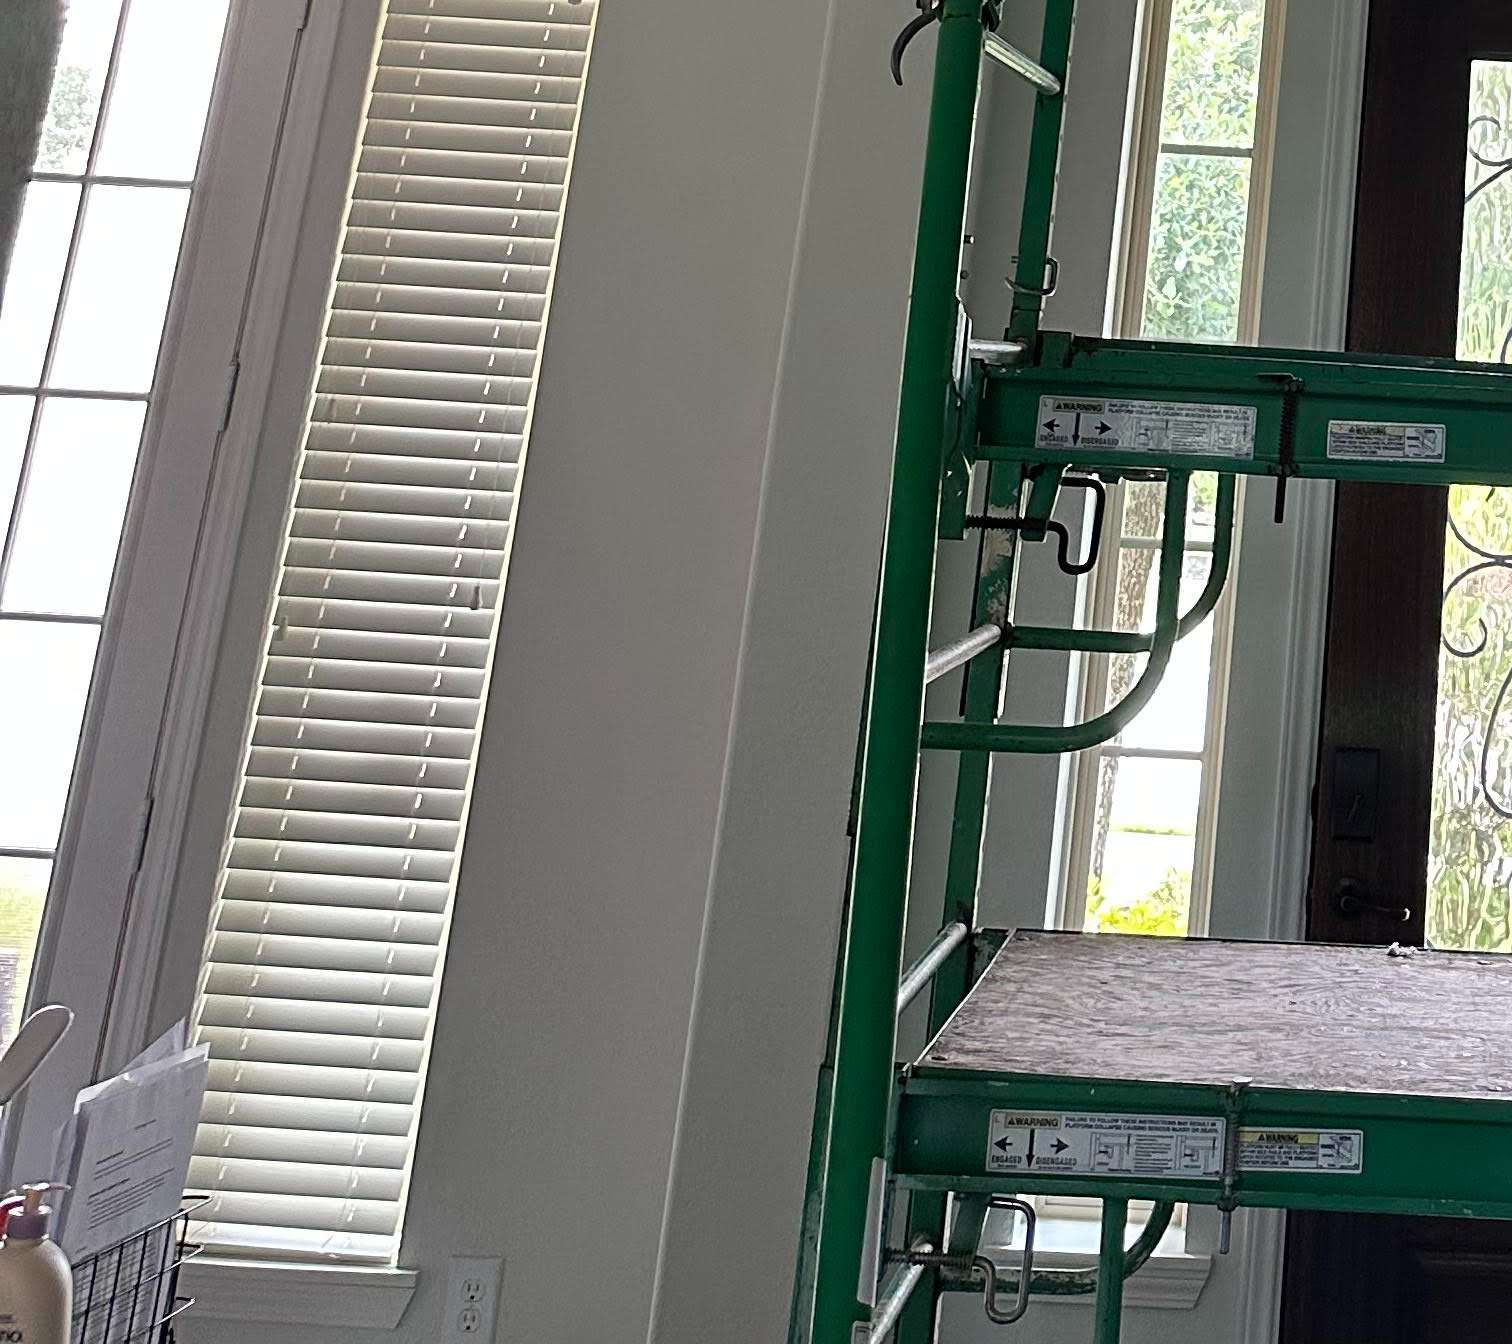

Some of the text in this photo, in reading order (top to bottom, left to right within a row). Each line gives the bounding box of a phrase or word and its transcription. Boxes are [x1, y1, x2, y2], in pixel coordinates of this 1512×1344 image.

[1061, 402, 1102, 412] WARNING
[1014, 1117, 1059, 1128] WARNING
[992, 1154, 1022, 1165] ENGAGED
